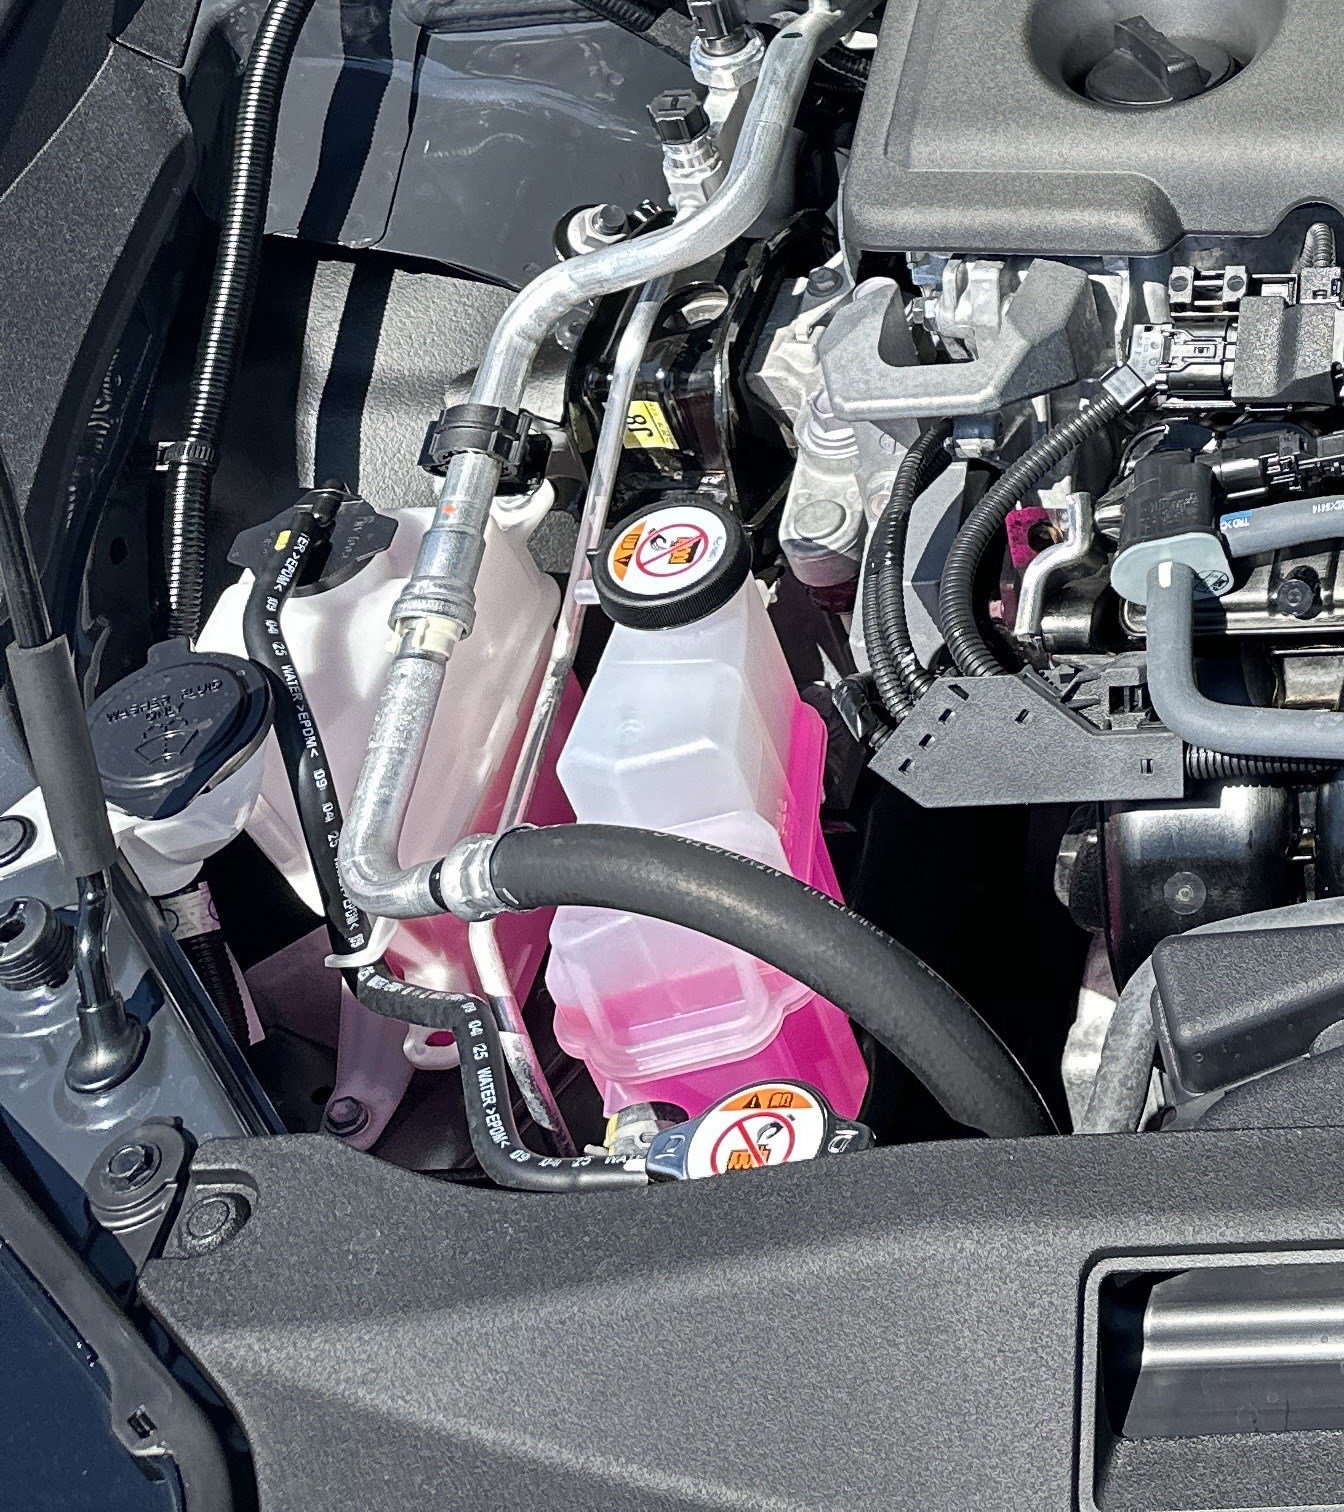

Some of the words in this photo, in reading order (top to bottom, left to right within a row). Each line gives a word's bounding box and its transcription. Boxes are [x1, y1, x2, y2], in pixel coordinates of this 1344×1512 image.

[106, 694, 171, 725] WASHER
[180, 678, 223, 700] FLUID
[281, 664, 303, 703] WATER
[145, 702, 185, 725] ONLY
[476, 1066, 498, 1108] WATER
